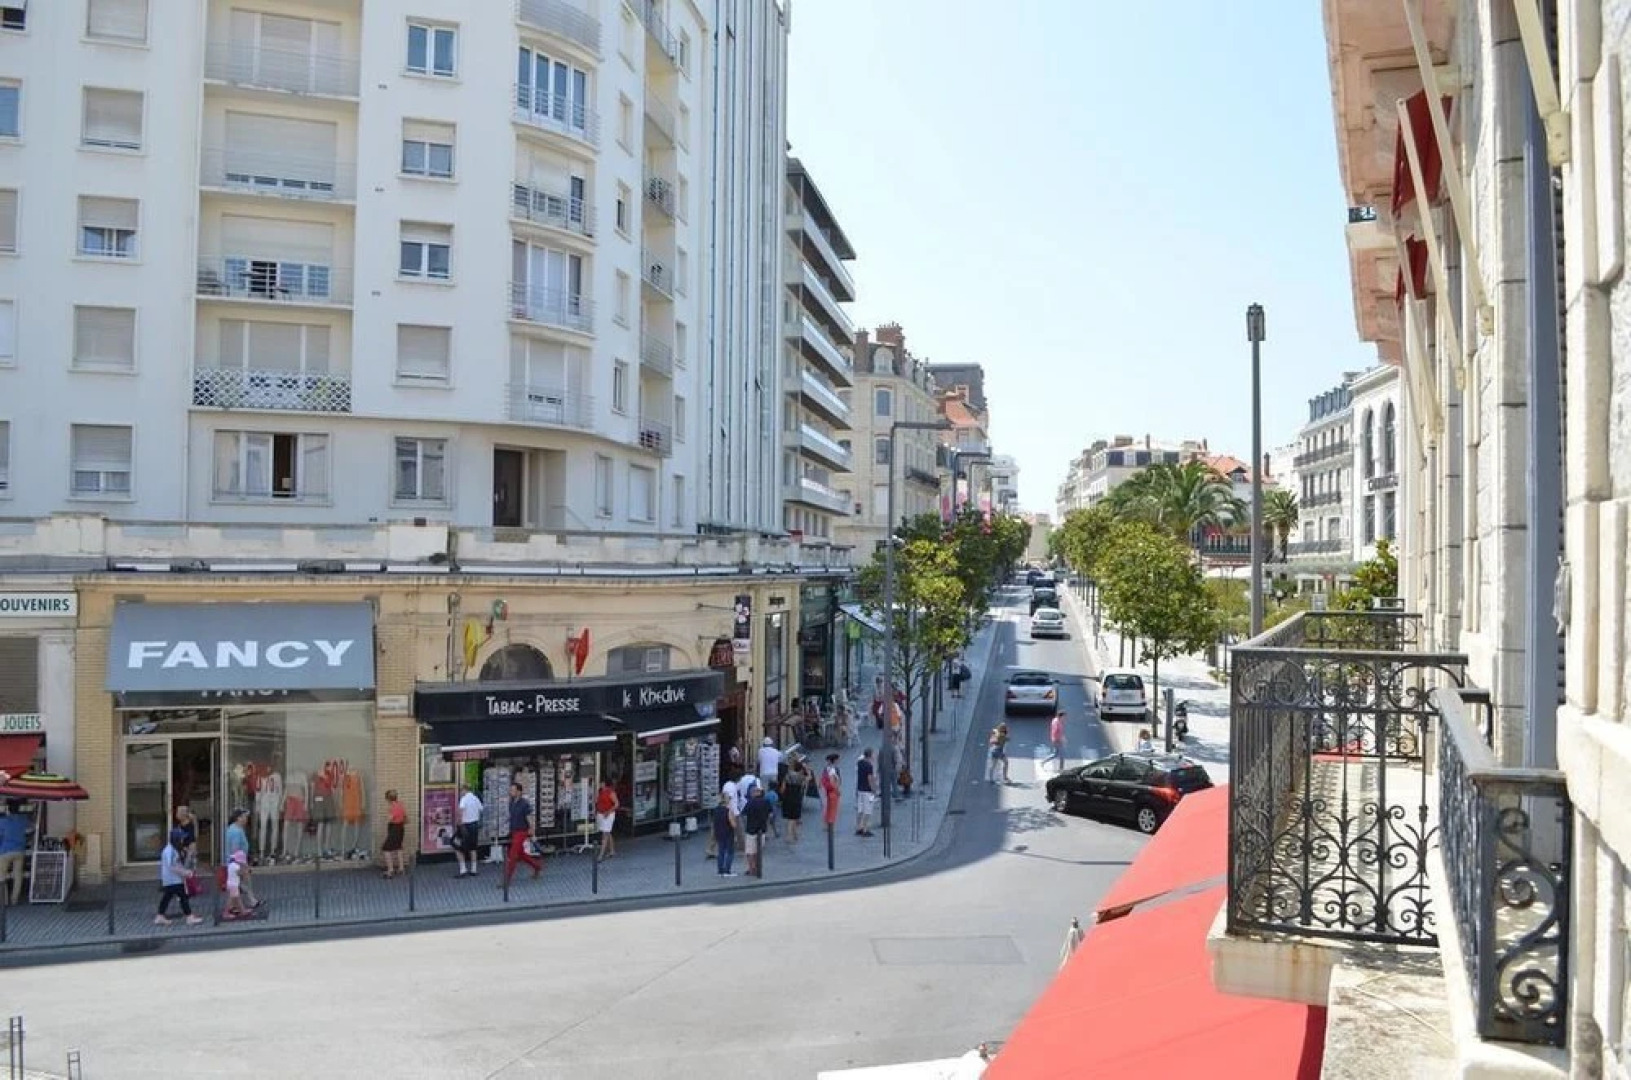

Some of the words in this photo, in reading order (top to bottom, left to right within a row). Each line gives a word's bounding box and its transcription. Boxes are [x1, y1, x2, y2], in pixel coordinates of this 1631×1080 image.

[0, 598, 70, 611] OUVENIRS
[127, 640, 354, 668] FANCY
[4, 715, 40, 729] JOUETS
